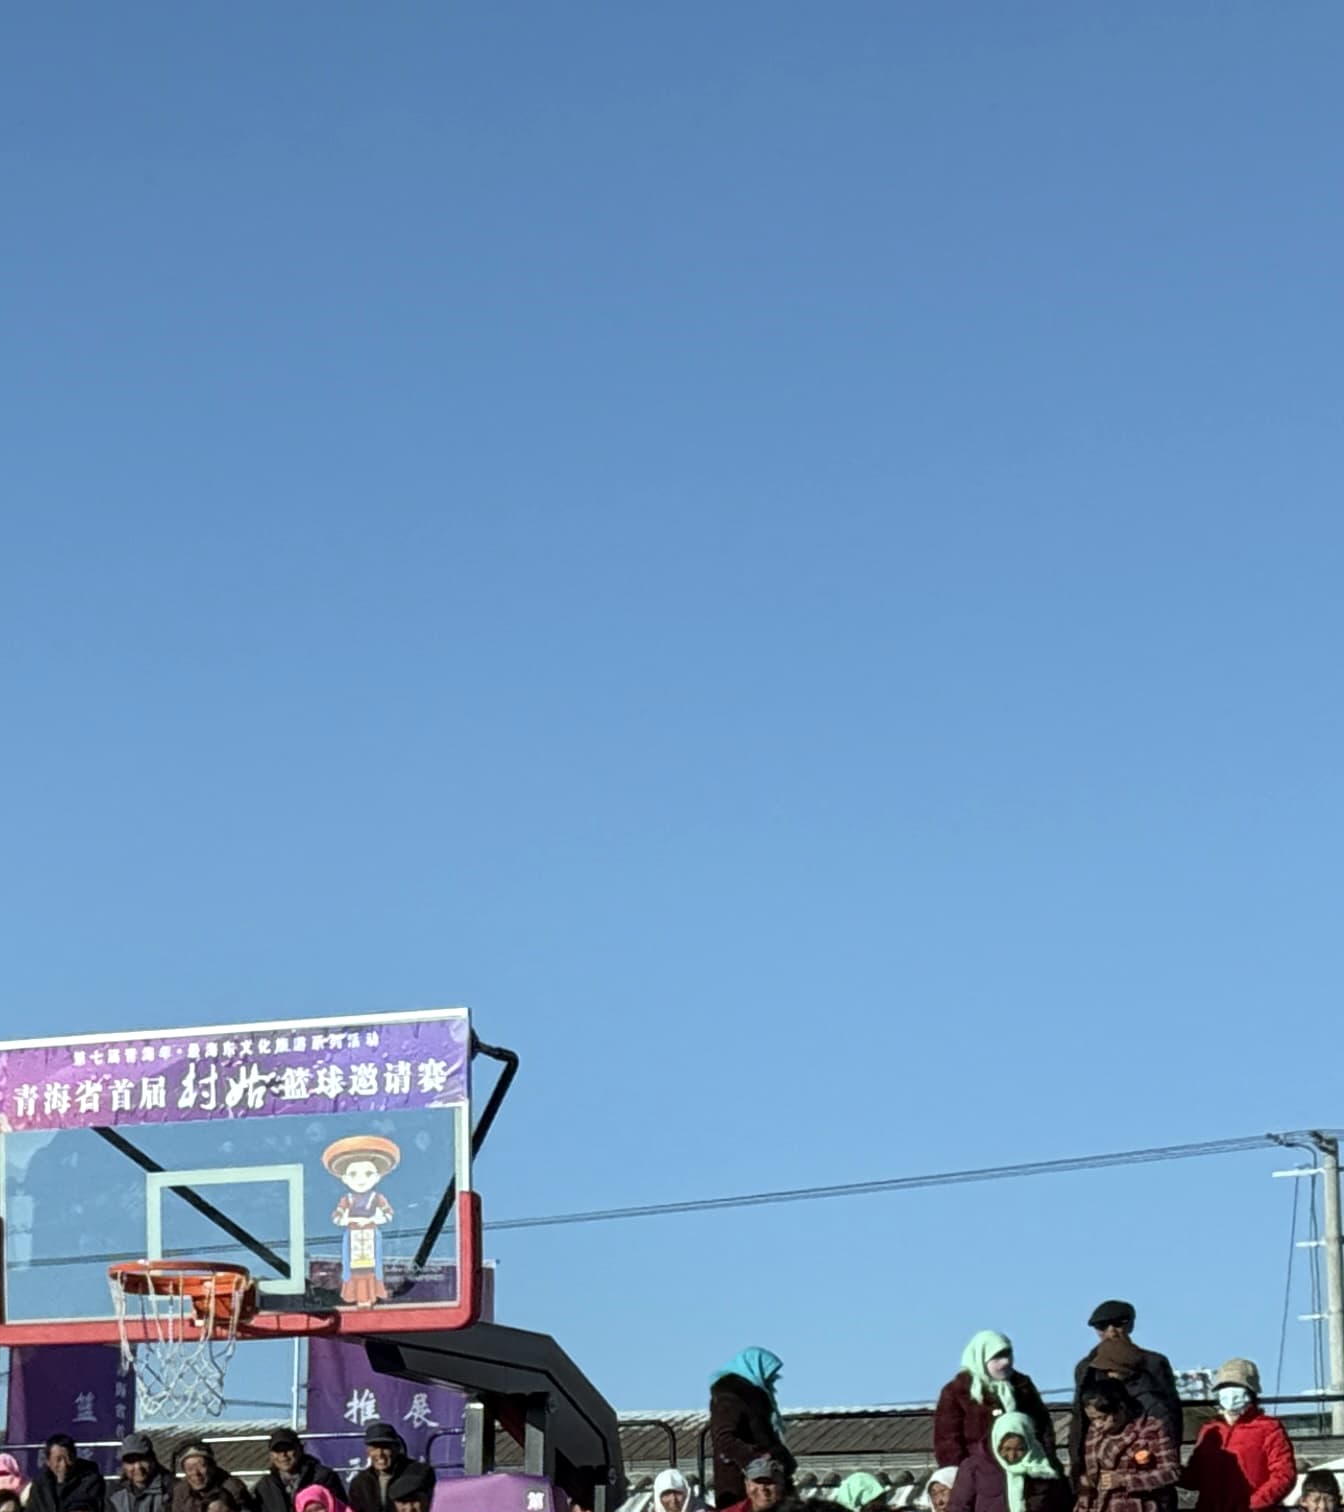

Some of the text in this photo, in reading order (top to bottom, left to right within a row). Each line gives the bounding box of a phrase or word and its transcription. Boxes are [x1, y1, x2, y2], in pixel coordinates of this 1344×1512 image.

[14, 1058, 448, 1117] 青海省首届村姑篮球邀请赛
